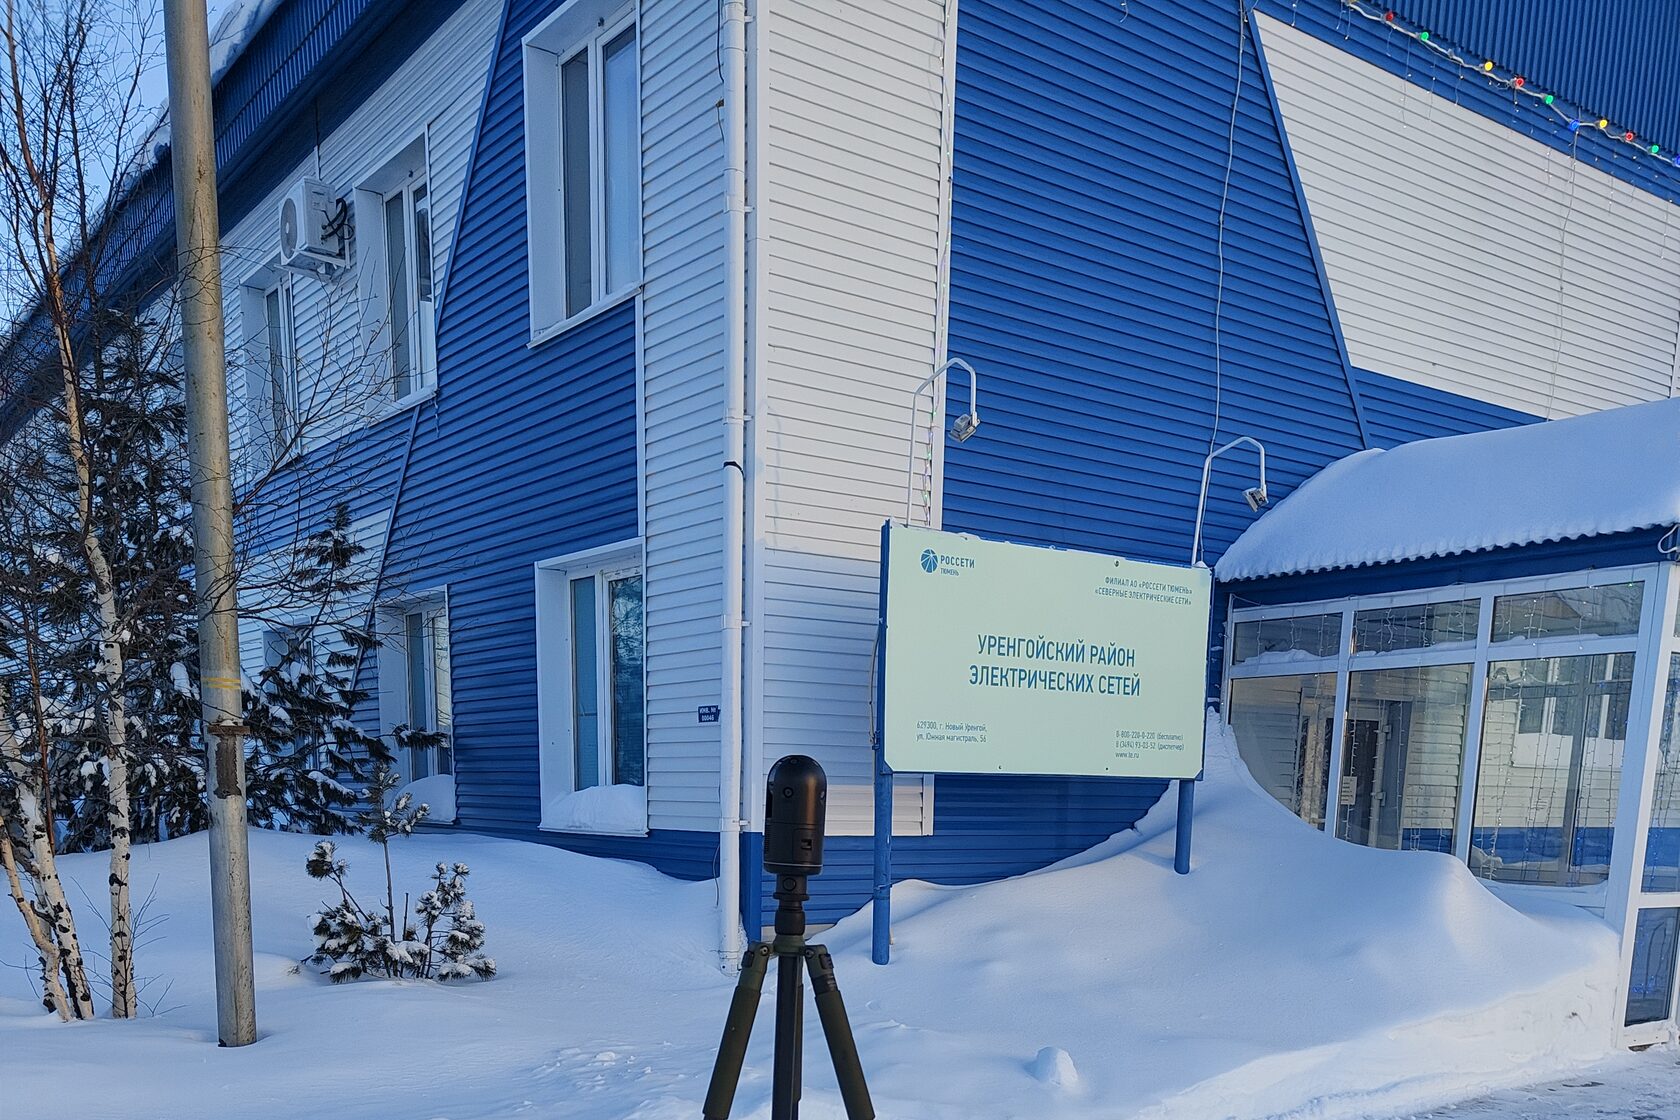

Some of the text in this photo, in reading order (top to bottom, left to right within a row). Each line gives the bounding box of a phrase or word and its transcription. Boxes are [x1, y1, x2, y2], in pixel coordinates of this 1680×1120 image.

[940, 555, 975, 568] РОССЕТИ
[940, 568, 960, 577] ТЮМЕНЬ
[1105, 576, 1193, 594] ФИЛИАЛ АО «РОССЕТИ ТЮМЕНЬ»
[1095, 587, 1192, 605] «СЕВЕРНЫЕ ЭЛЕКТРИЧЕСКИЕ СЕТИ»
[977, 634, 1135, 667] УРЕНГОЙСКИЙ РАЙОН
[969, 665, 1141, 697] ЭЛЕКТРИЧЕСКИХ СЕТЕЙ
[916, 720, 938, 731] 629300,
[945, 722, 963, 731] Новый
